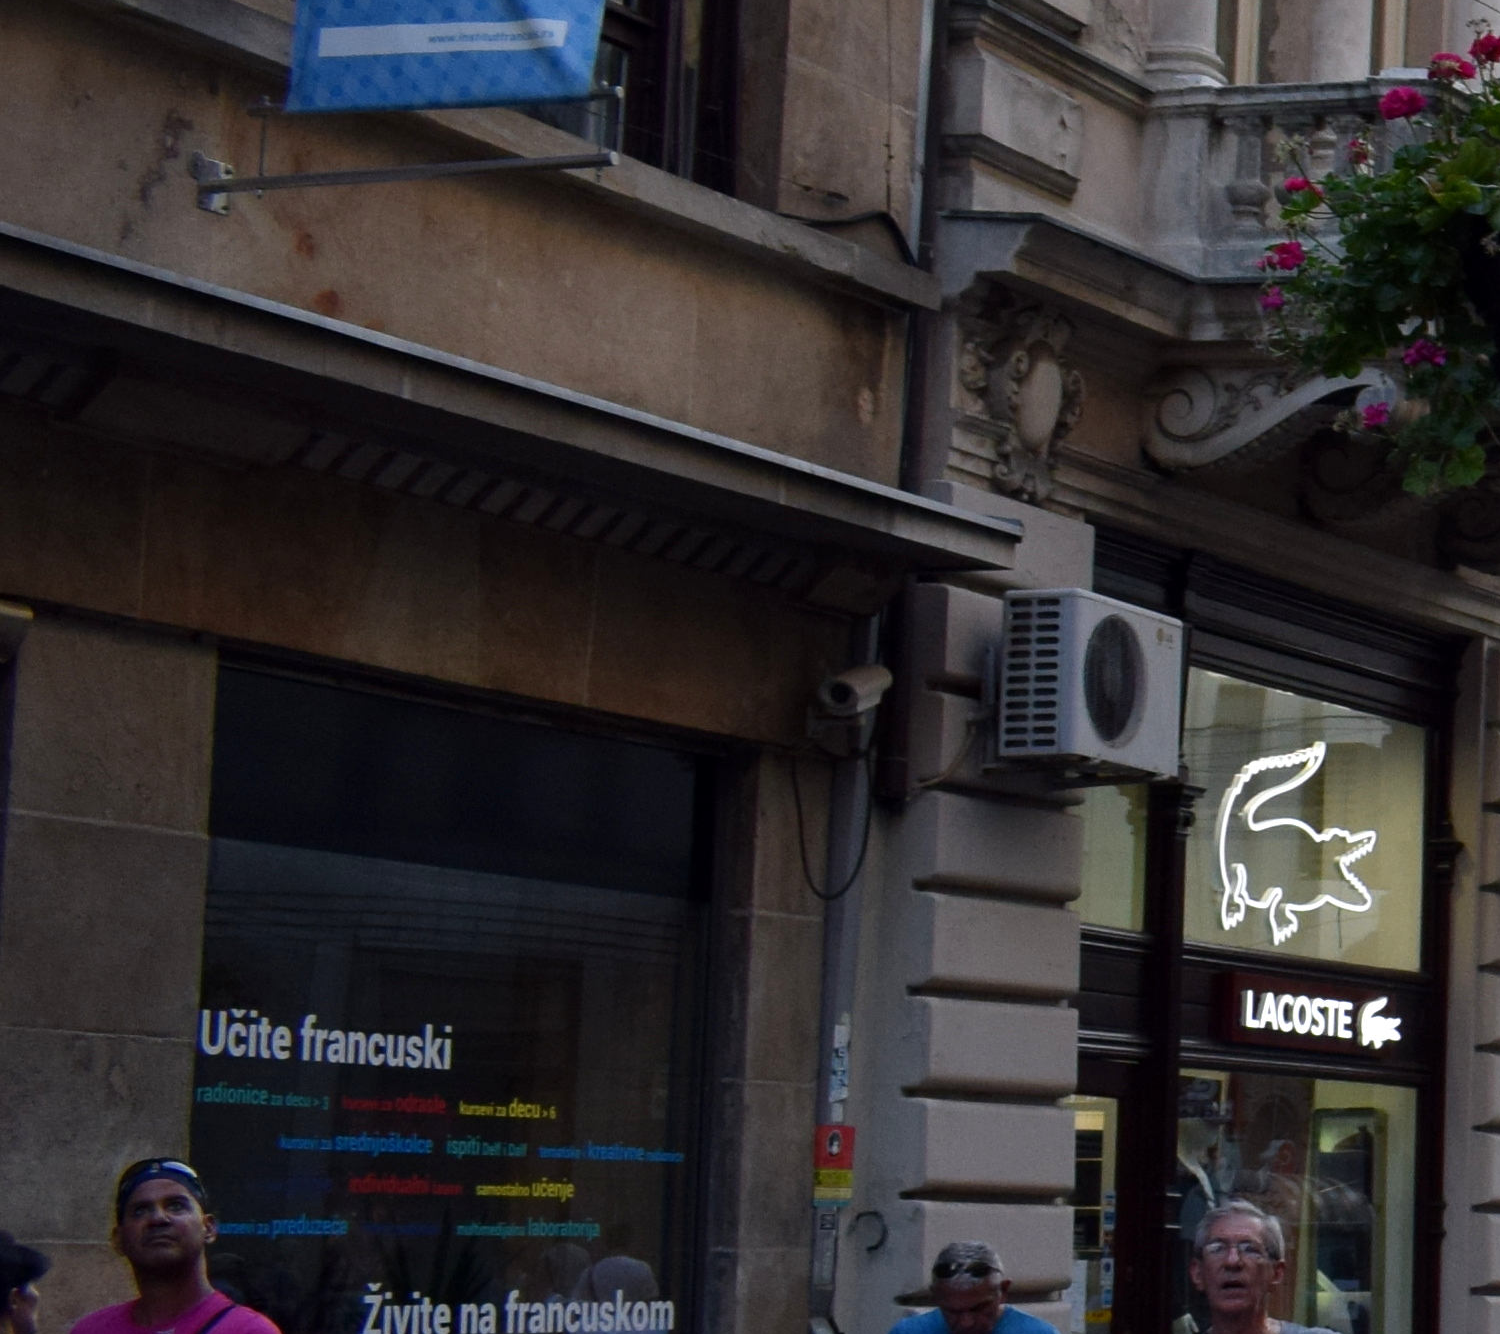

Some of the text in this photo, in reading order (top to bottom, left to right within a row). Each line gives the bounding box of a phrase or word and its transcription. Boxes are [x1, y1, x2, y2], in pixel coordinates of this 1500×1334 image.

[1240, 989, 1354, 1039] LACOSTE
[200, 1008, 453, 1070] Učite francuski
[197, 1081, 268, 1105] radionice
[508, 1097, 541, 1118] decu
[532, 1177, 576, 1203] učenje
